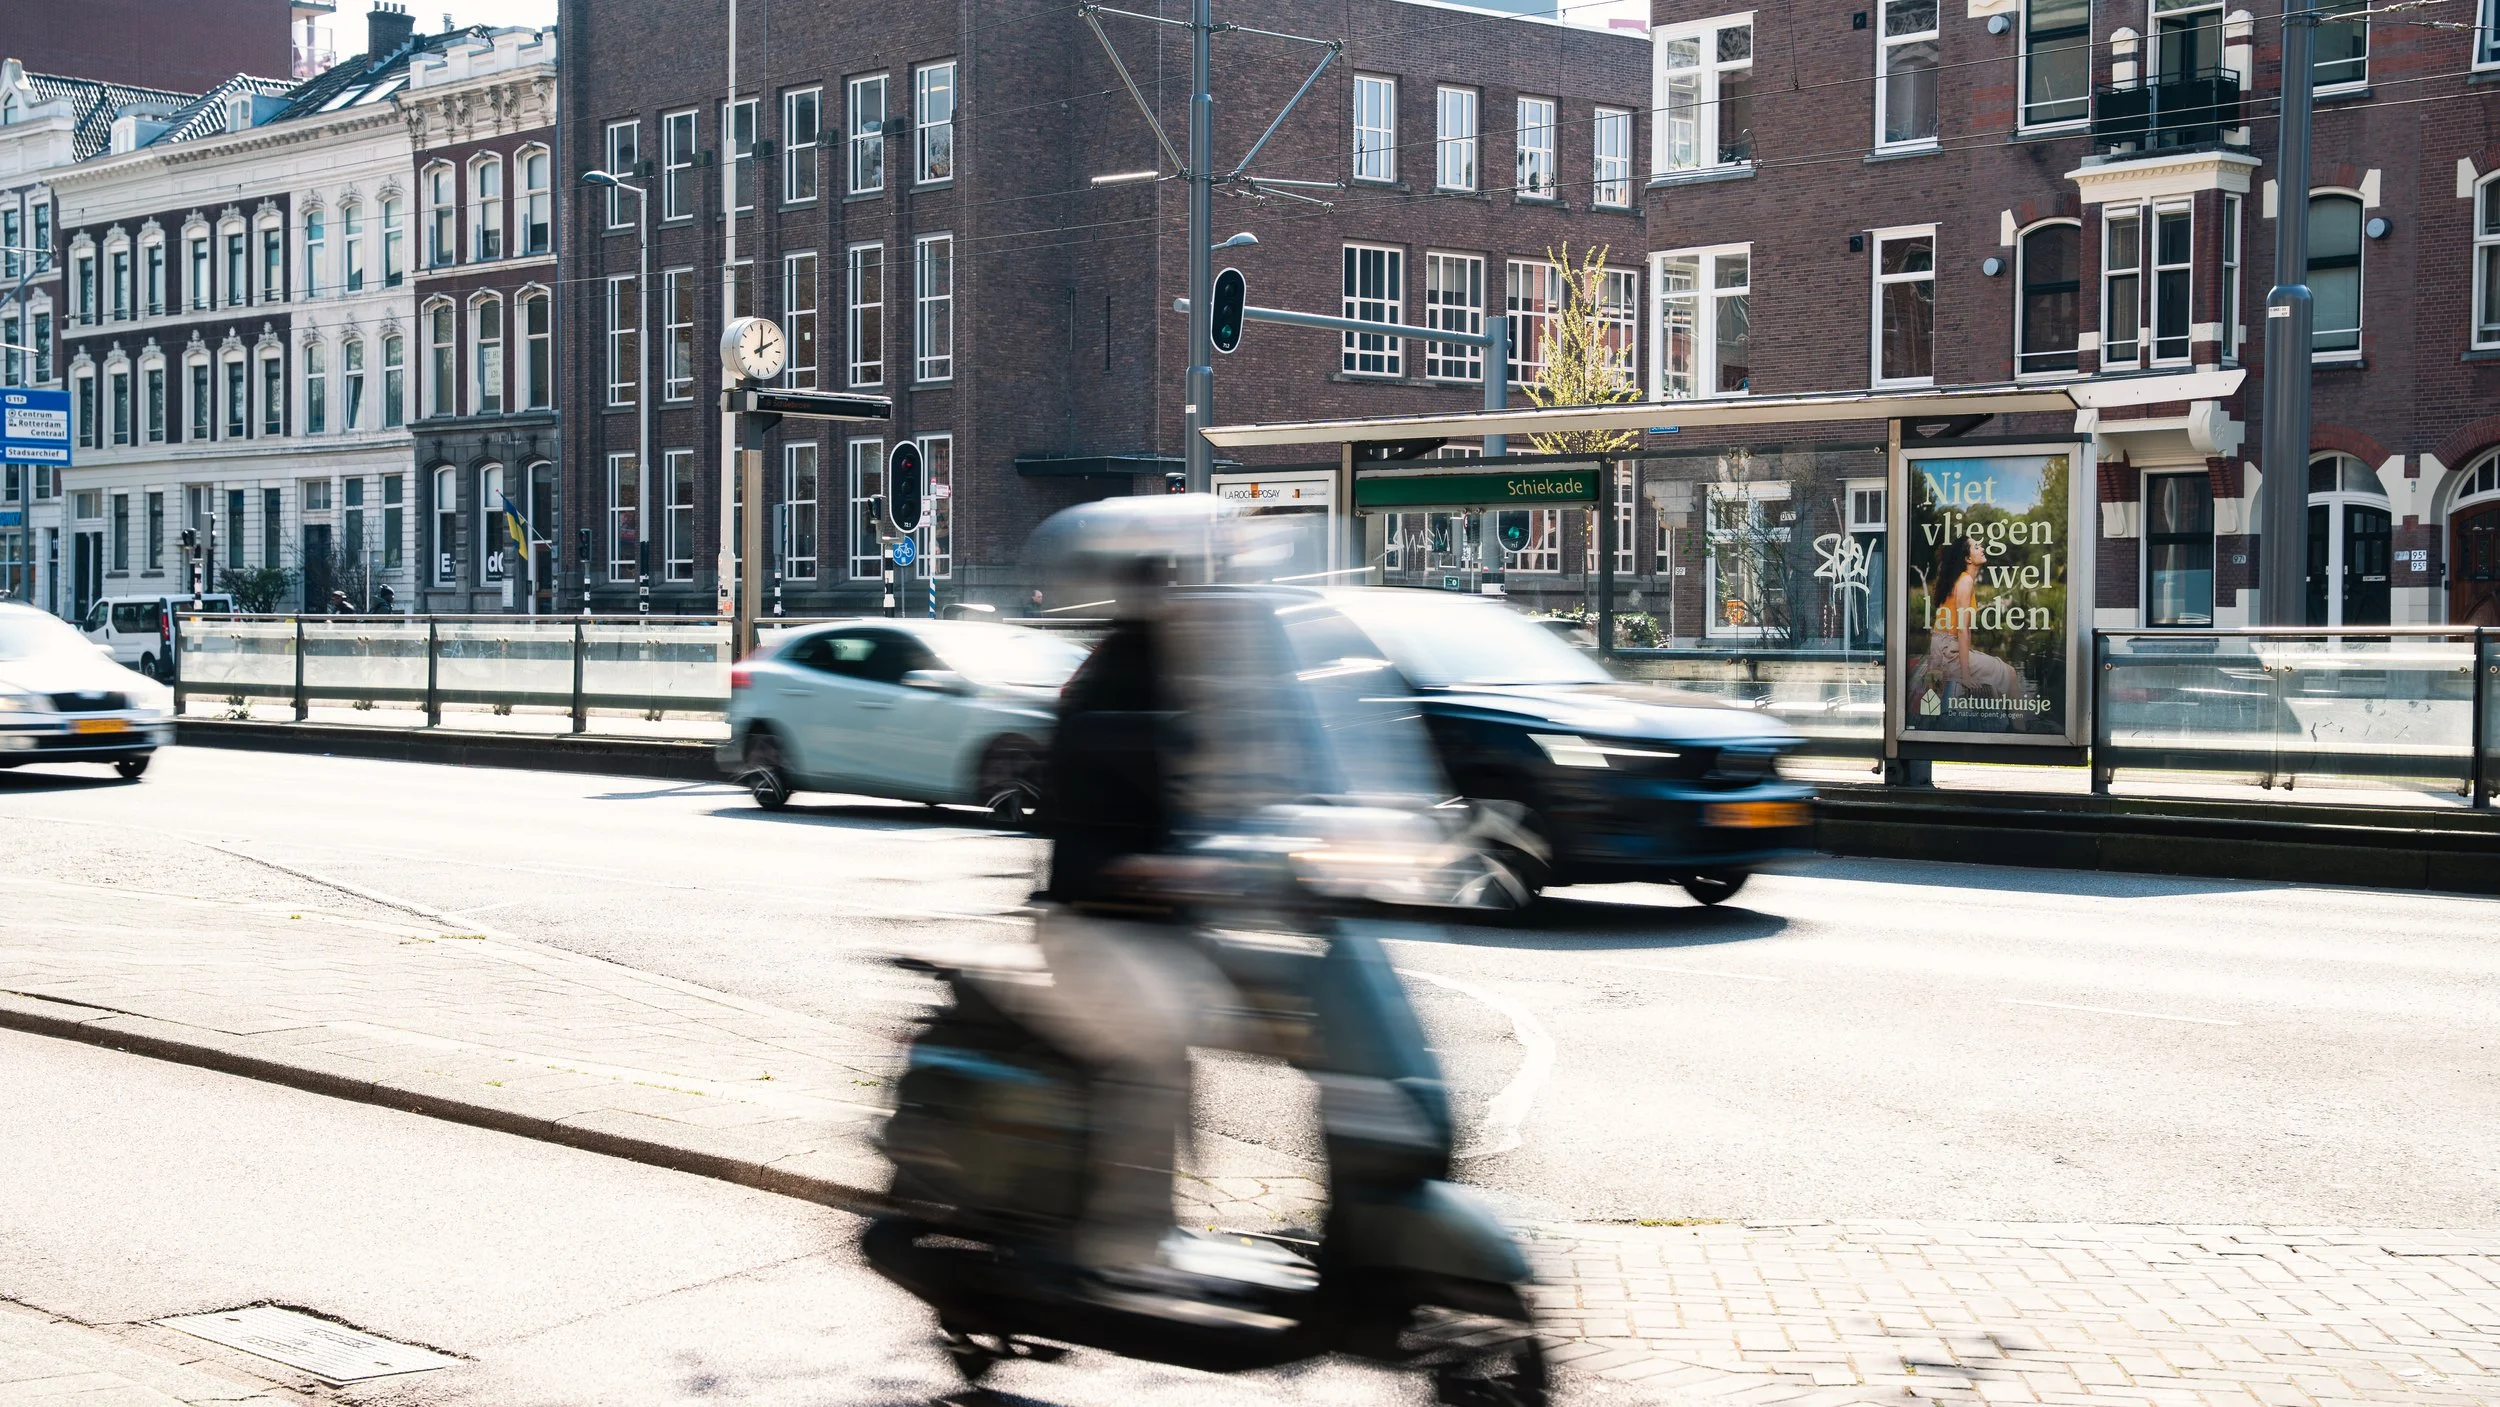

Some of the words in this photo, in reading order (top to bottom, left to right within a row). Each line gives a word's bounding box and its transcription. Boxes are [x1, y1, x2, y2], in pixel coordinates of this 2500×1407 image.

[17, 410, 53, 418] Centrum
[18, 419, 61, 428] Rotterdam
[30, 428, 65, 437] Centraal
[8, 448, 60, 457] Stadsarchief
[1507, 477, 1583, 496] Schiekade
[1923, 471, 1998, 505] Niet
[1224, 490, 1235, 499] LA
[1258, 489, 1280, 498] POSAY
[1921, 511, 2054, 556] vliegen
[1987, 554, 2053, 589] wel
[1922, 595, 2051, 631] landen
[1948, 693, 2051, 715] natuurhuisje
[1980, 711, 2000, 719] opent
[2008, 712, 2024, 720] ogen
